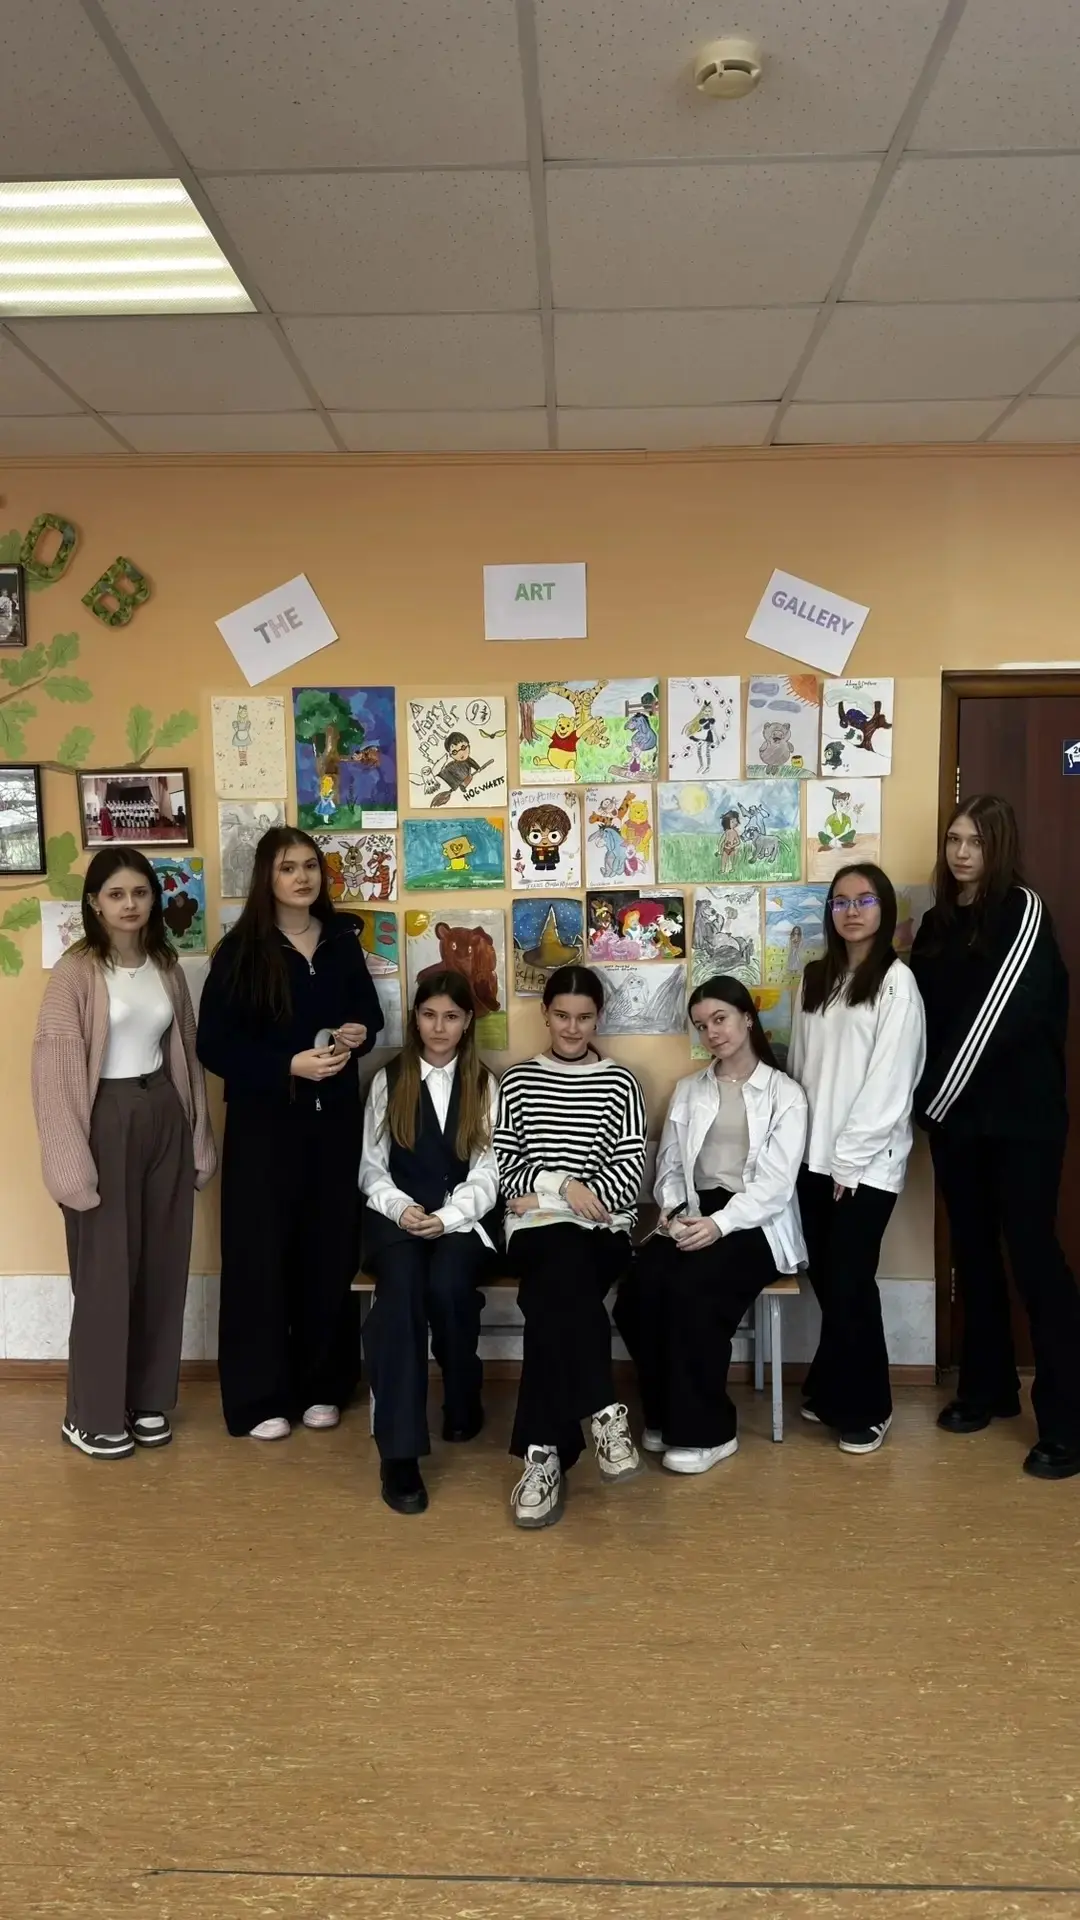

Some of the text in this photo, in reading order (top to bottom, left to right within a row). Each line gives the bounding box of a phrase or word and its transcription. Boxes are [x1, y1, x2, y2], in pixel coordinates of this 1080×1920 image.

[514, 582, 556, 601] ART
[253, 606, 303, 644] THE
[771, 590, 854, 636] GALLERY
[412, 700, 447, 740] Harry
[463, 775, 505, 802] HOGWARTS
